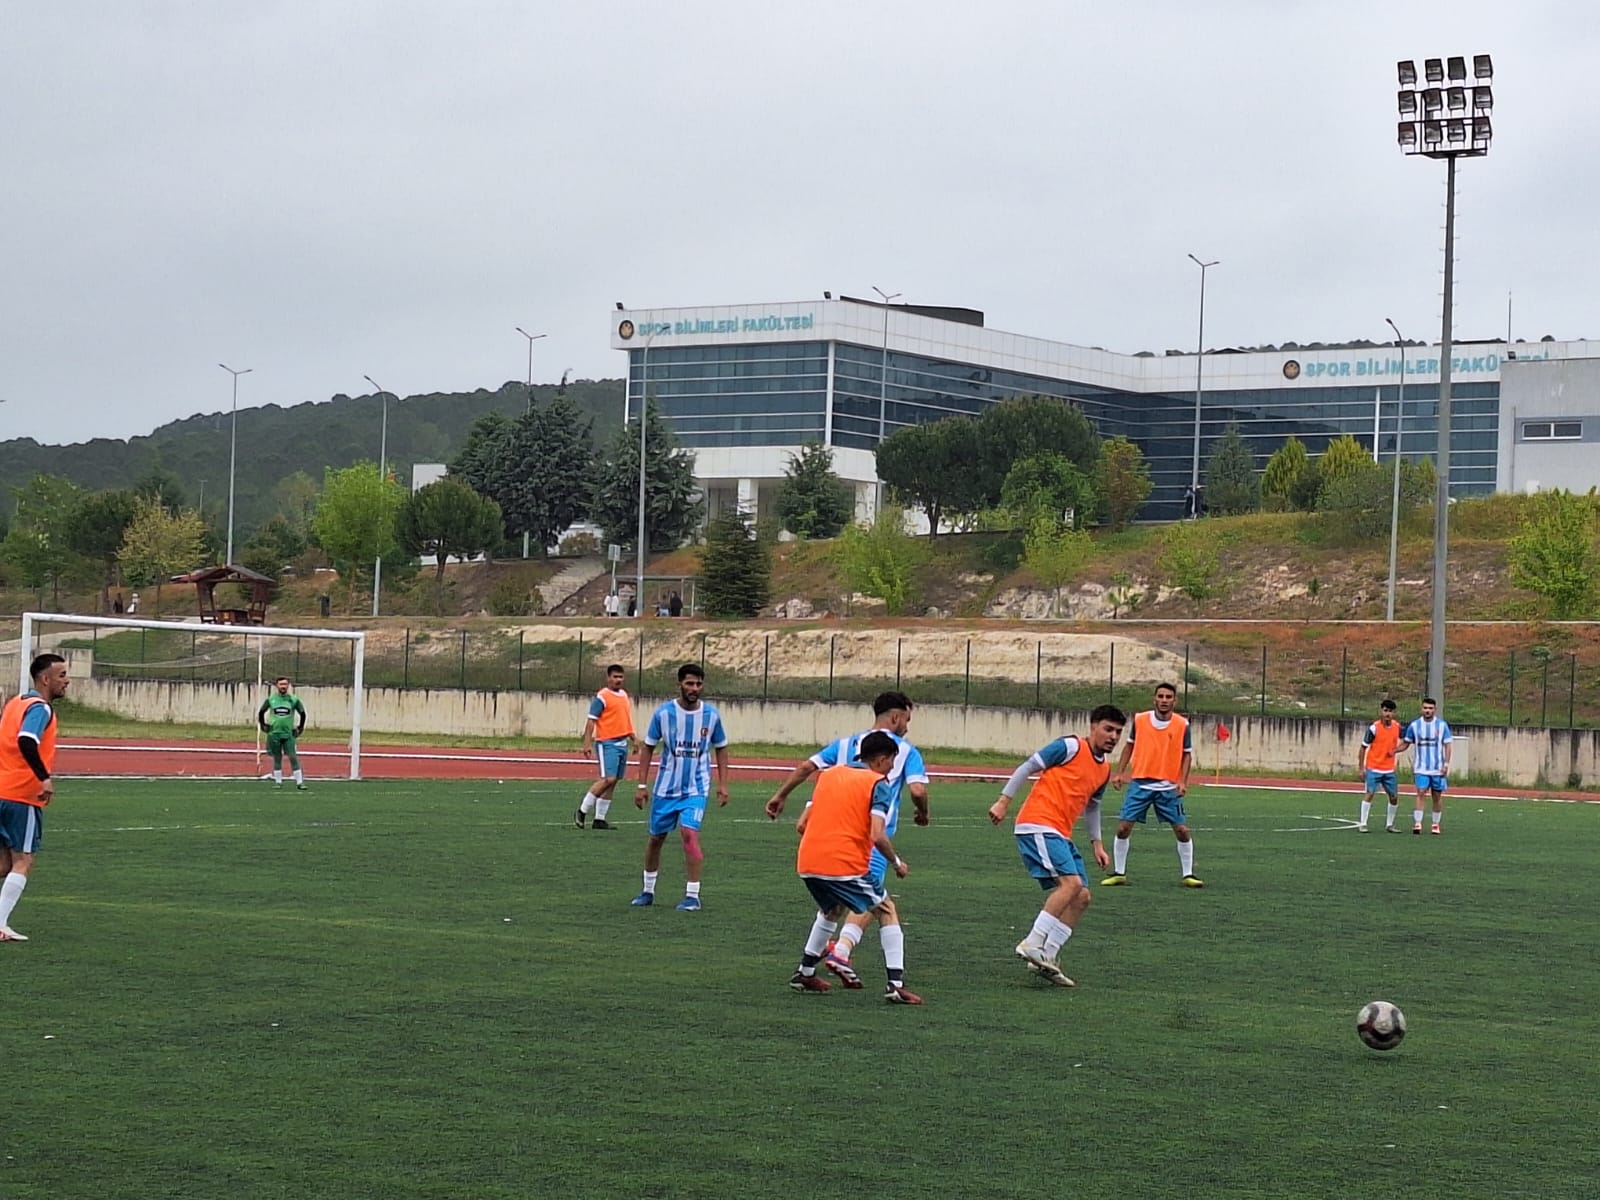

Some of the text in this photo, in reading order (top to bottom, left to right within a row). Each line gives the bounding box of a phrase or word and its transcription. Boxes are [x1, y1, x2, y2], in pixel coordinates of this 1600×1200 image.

[638, 313, 813, 336] SPOR BİLİMLERİ FAKÜLTESİ
[1306, 362, 1350, 377] SPOR
[1355, 357, 1441, 376] BİLİMLER
